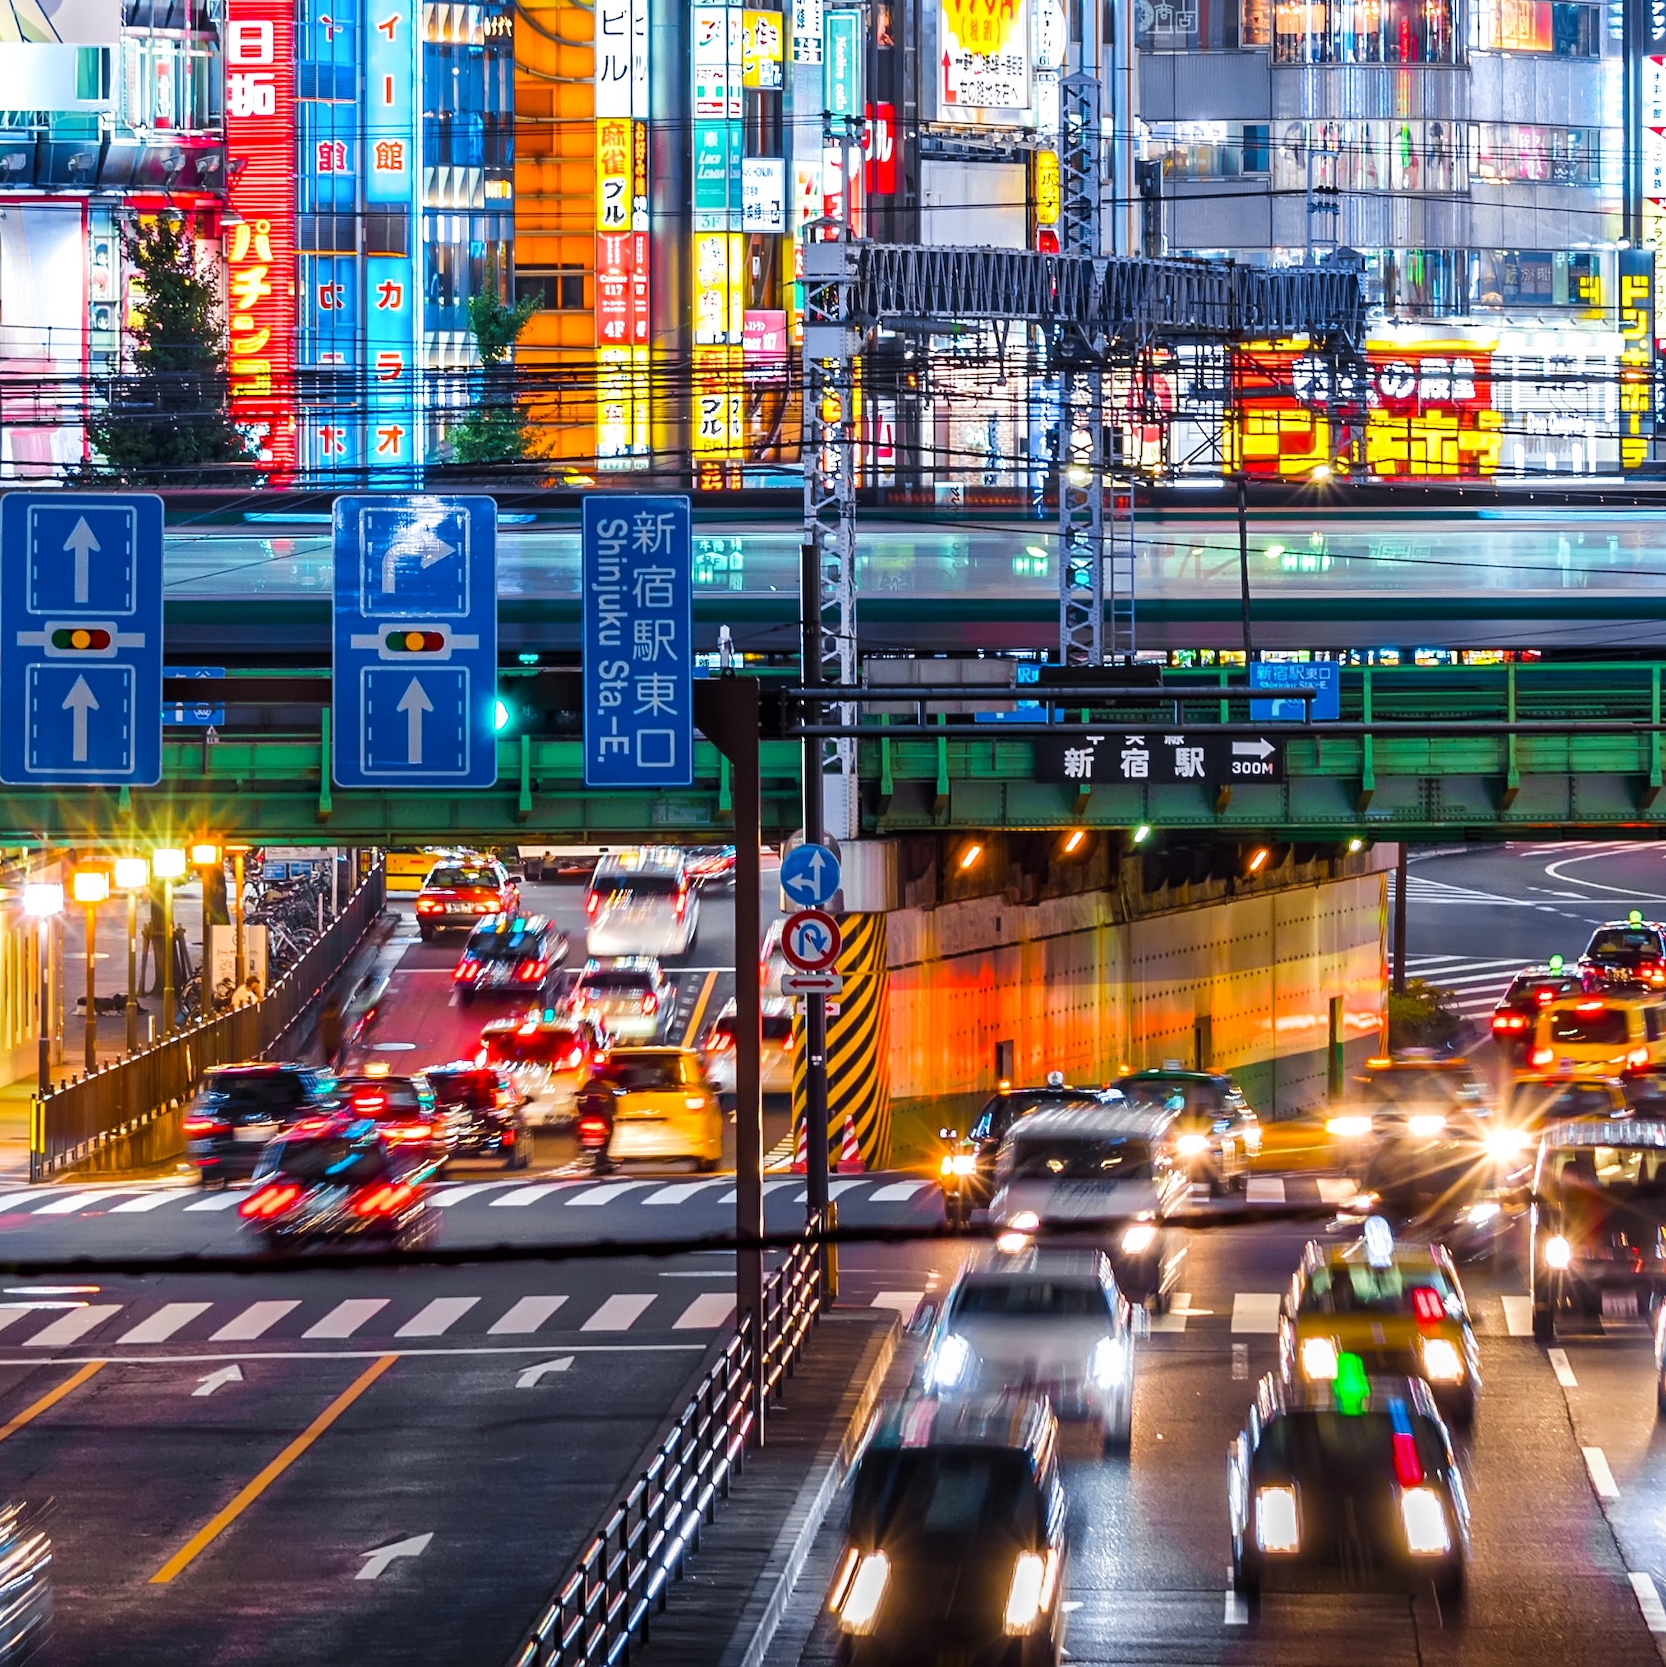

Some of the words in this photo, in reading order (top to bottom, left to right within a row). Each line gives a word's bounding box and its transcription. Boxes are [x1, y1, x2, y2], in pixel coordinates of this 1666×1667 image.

[231, 219, 274, 399] パチンコ
[597, 518, 628, 648] Shinjuku
[631, 510, 676, 769] 新宿駅東口
[1256, 665, 1332, 682] 新宿駅東口
[1063, 746, 1206, 780] 新宿駅
[1232, 761, 1274, 776] 300M
